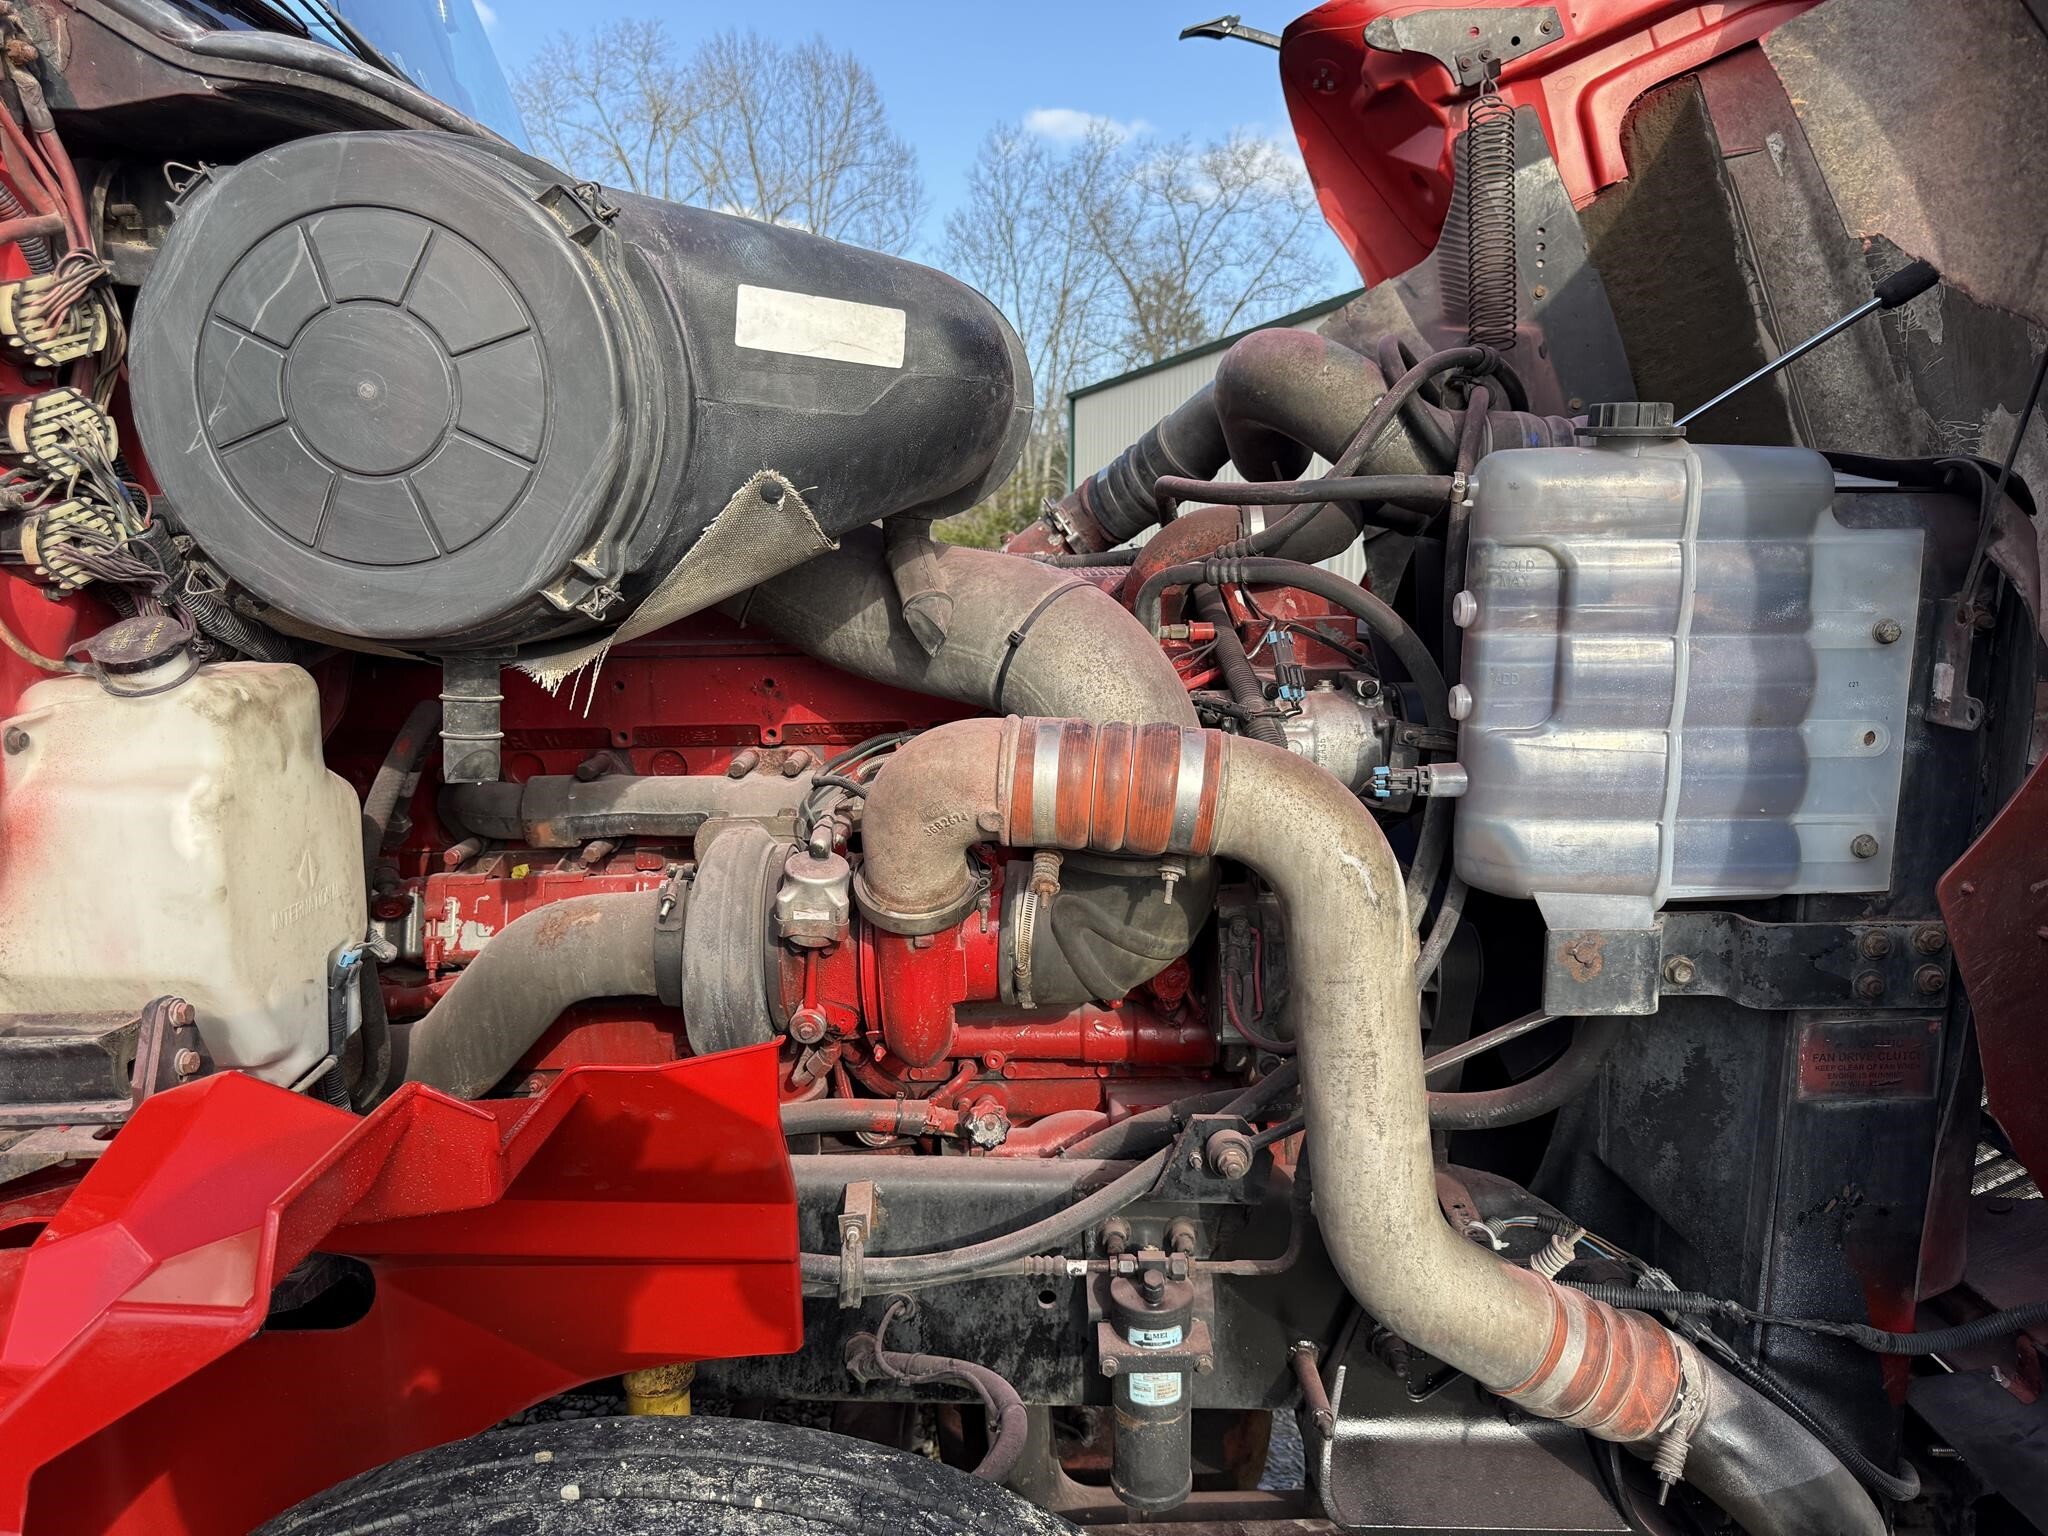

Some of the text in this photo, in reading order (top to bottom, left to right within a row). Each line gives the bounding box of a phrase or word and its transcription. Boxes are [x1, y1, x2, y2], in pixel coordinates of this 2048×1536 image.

[1812, 1053, 1835, 1063] FAN
[1838, 1053, 1873, 1062] DRIVE
[1815, 1064, 1835, 1072] KEEP
[1866, 1063, 1877, 1071] OF
